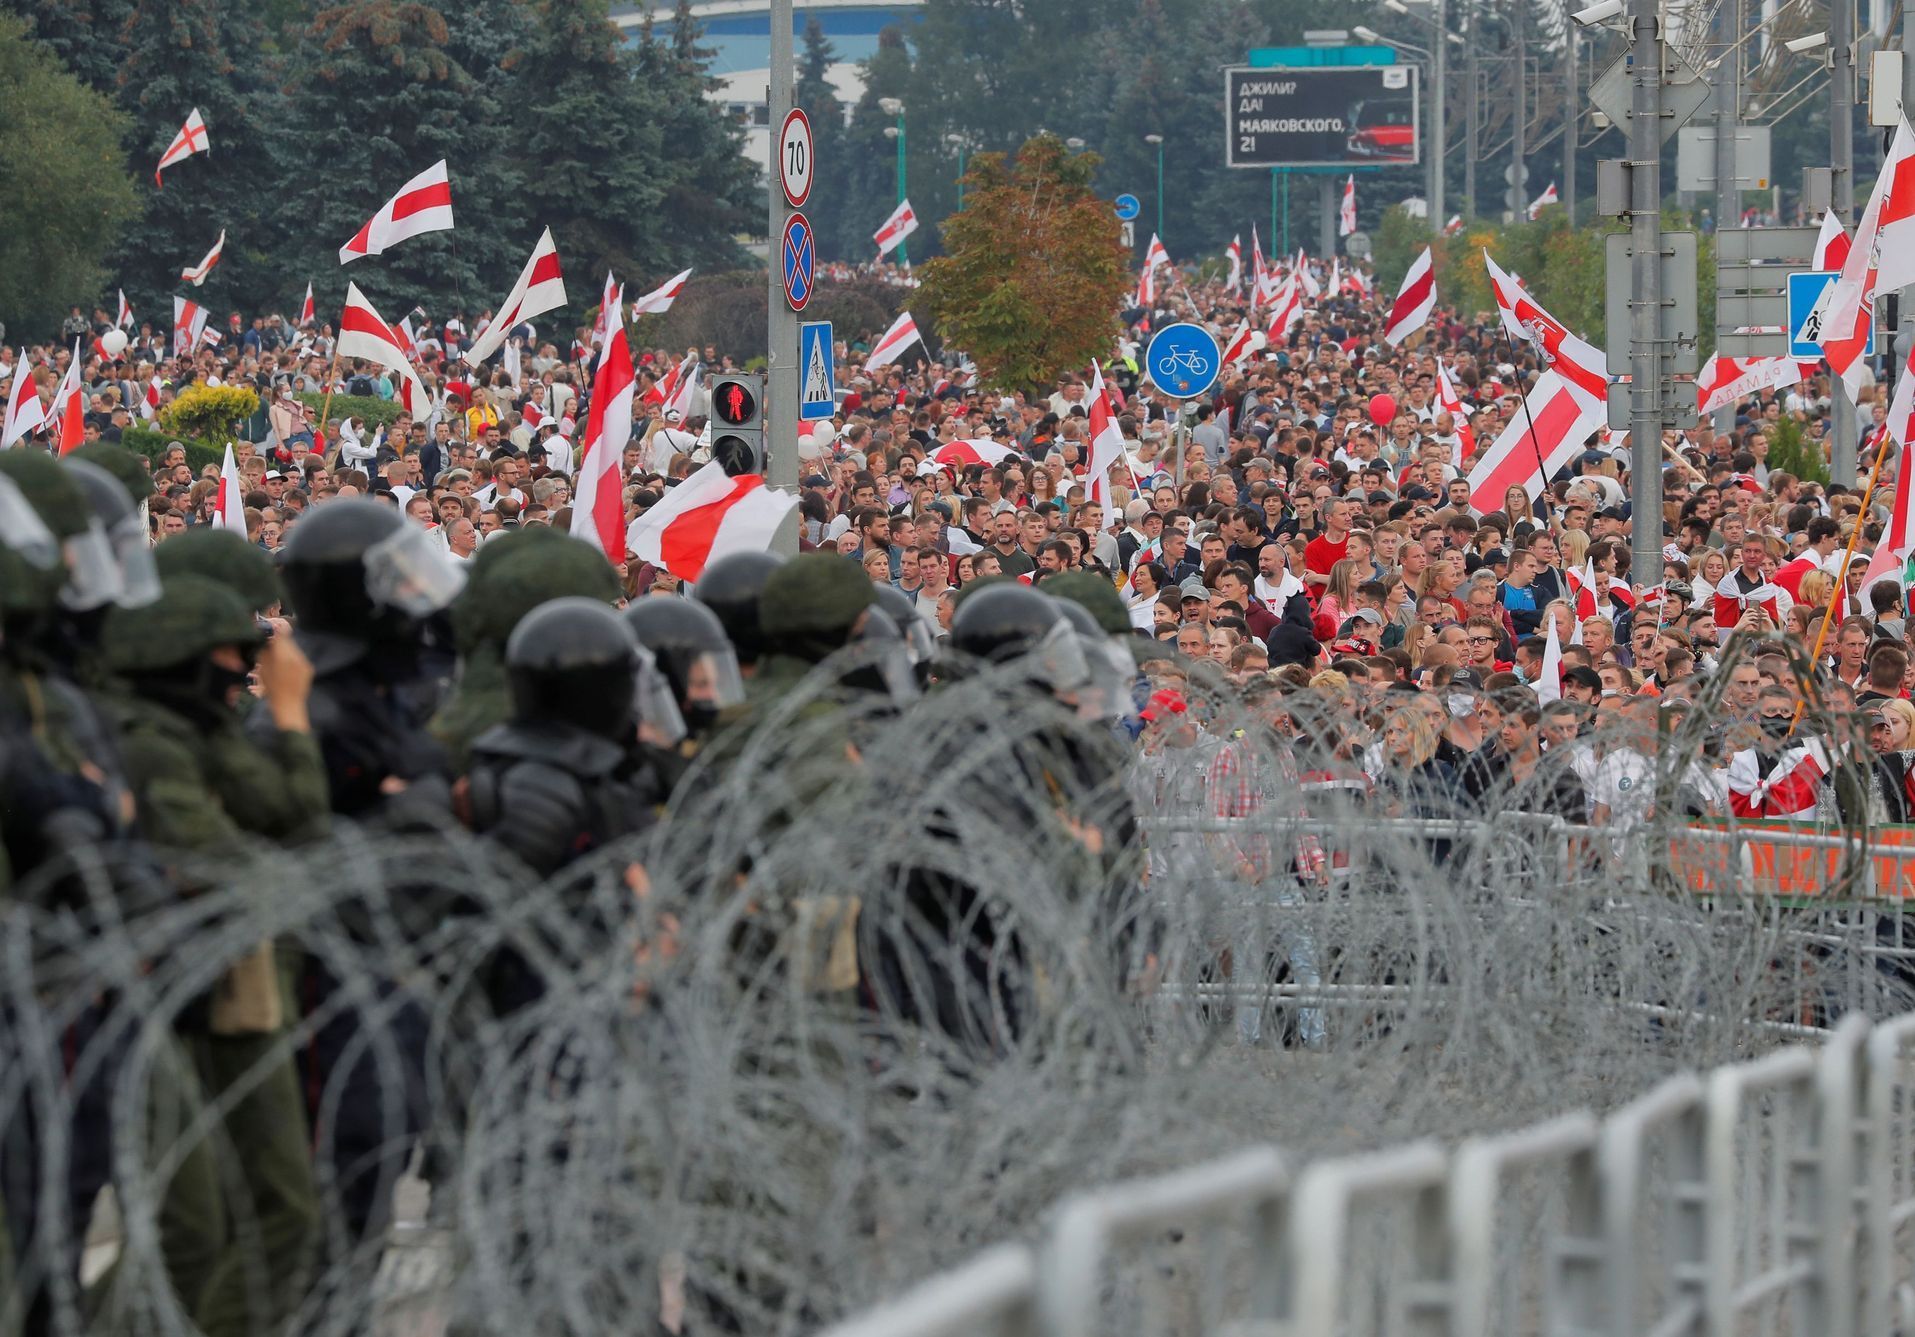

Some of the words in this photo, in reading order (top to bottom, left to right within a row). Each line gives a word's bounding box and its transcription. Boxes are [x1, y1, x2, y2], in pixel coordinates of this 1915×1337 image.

[1239, 82, 1297, 96] ДЖИЛИ?
[1239, 98, 1264, 113] ДА!
[1240, 118, 1345, 133] МАЯКОВСКОГО,
[1240, 136, 1256, 152] 2!
[788, 140, 804, 176] 70
